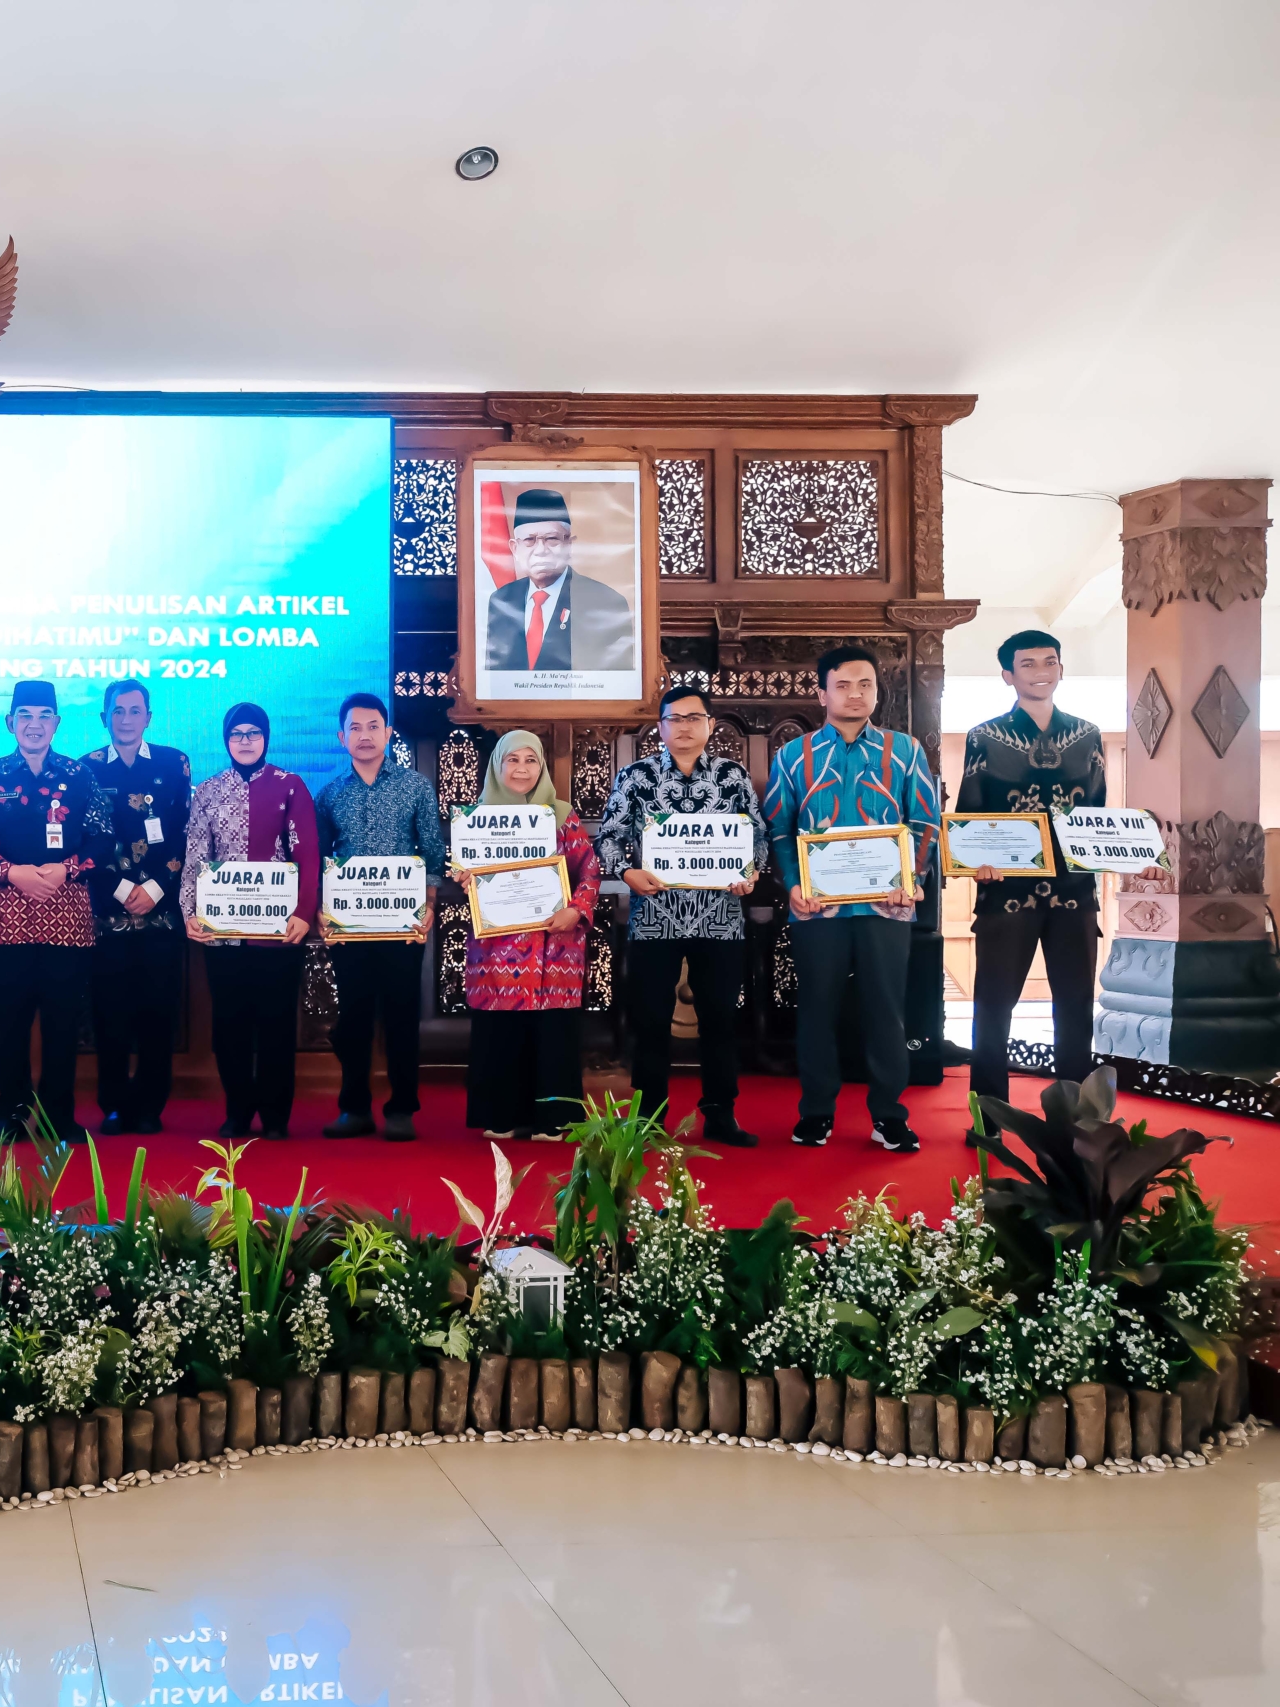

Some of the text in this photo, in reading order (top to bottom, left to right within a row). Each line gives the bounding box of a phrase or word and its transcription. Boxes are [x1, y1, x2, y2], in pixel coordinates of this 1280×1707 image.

[71, 595, 227, 615] PENULISAN
[236, 595, 350, 616] ARTIKEL
[149, 627, 210, 647] DAN
[220, 627, 320, 648] LOMBA
[52, 659, 151, 678] TAHUN
[160, 659, 227, 679] 2024
[467, 815, 539, 829] JUARA V
[1067, 815, 1146, 830] JUARA VIII
[657, 823, 739, 838] JUARA VI
[461, 846, 546, 860] Rp. 3.000.000
[1070, 844, 1156, 859] Rp. 3.000.000
[653, 857, 743, 871] Rp. 3.000.000
[212, 871, 285, 885] JUARA III
[337, 866, 412, 880] JUARA IV
[206, 903, 288, 917] Rp. 3.000.000
[333, 897, 417, 911] Rp. 3.000.000
